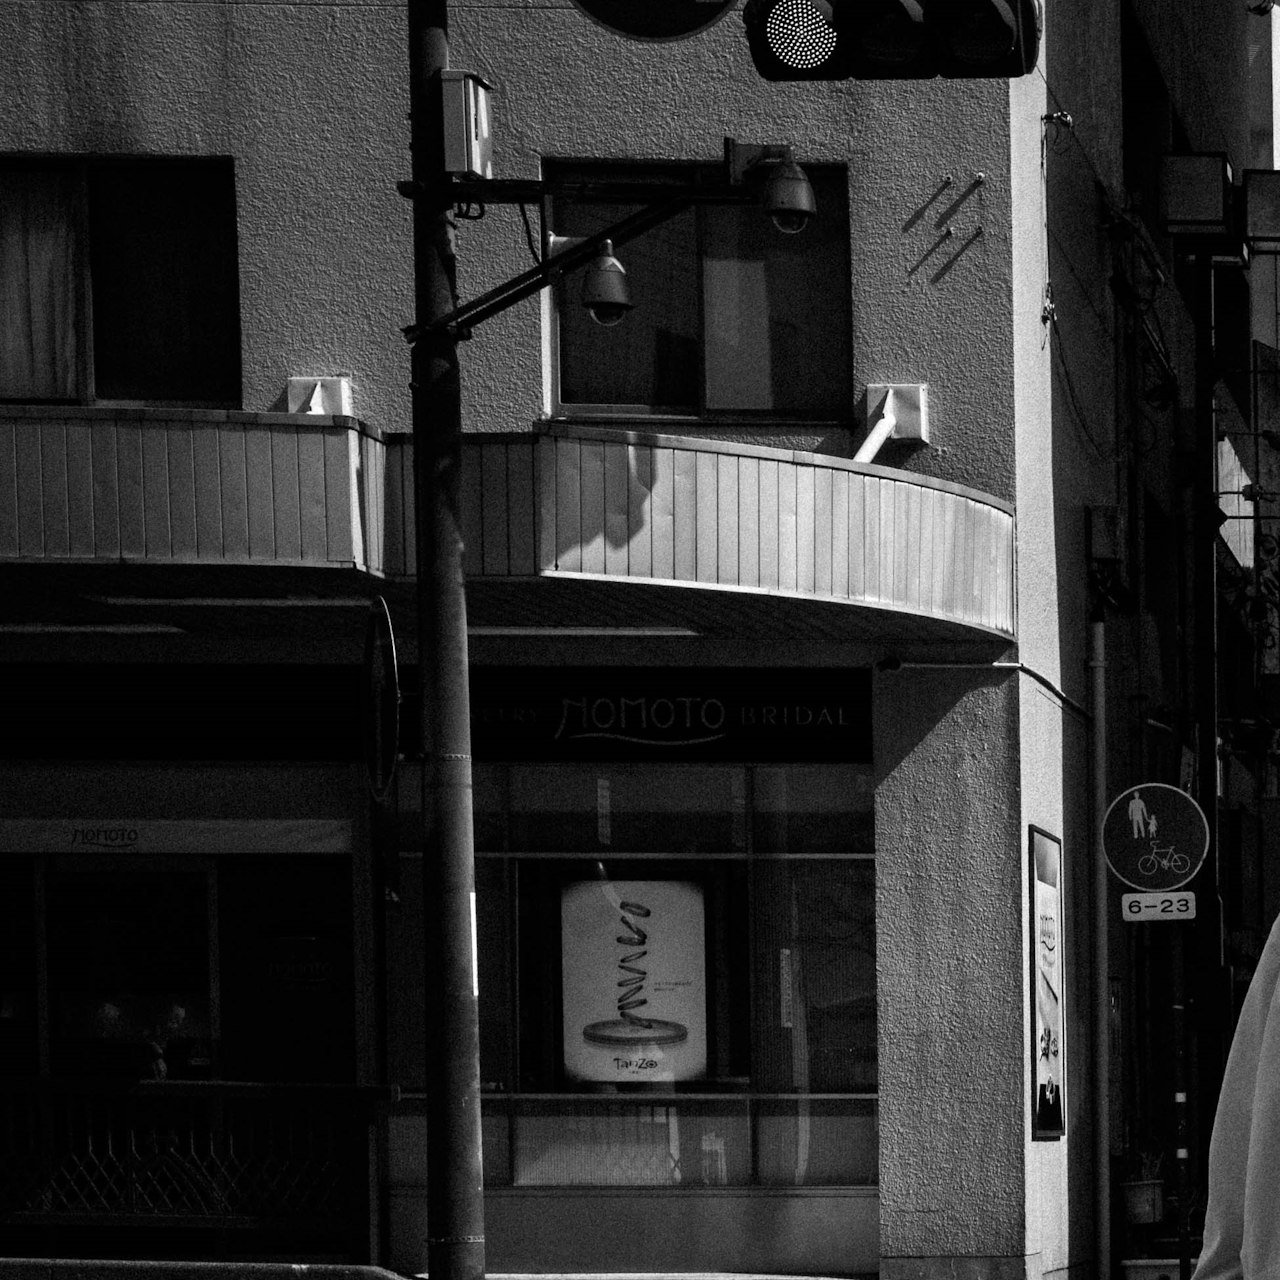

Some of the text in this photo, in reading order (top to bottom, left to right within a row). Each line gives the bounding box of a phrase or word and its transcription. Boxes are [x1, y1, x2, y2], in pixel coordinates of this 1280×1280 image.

[554, 697, 726, 742] MOMOTO
[740, 705, 850, 726] BRIDAL
[71, 828, 139, 847] MOMOTO
[1128, 898, 1190, 914] 6-23
